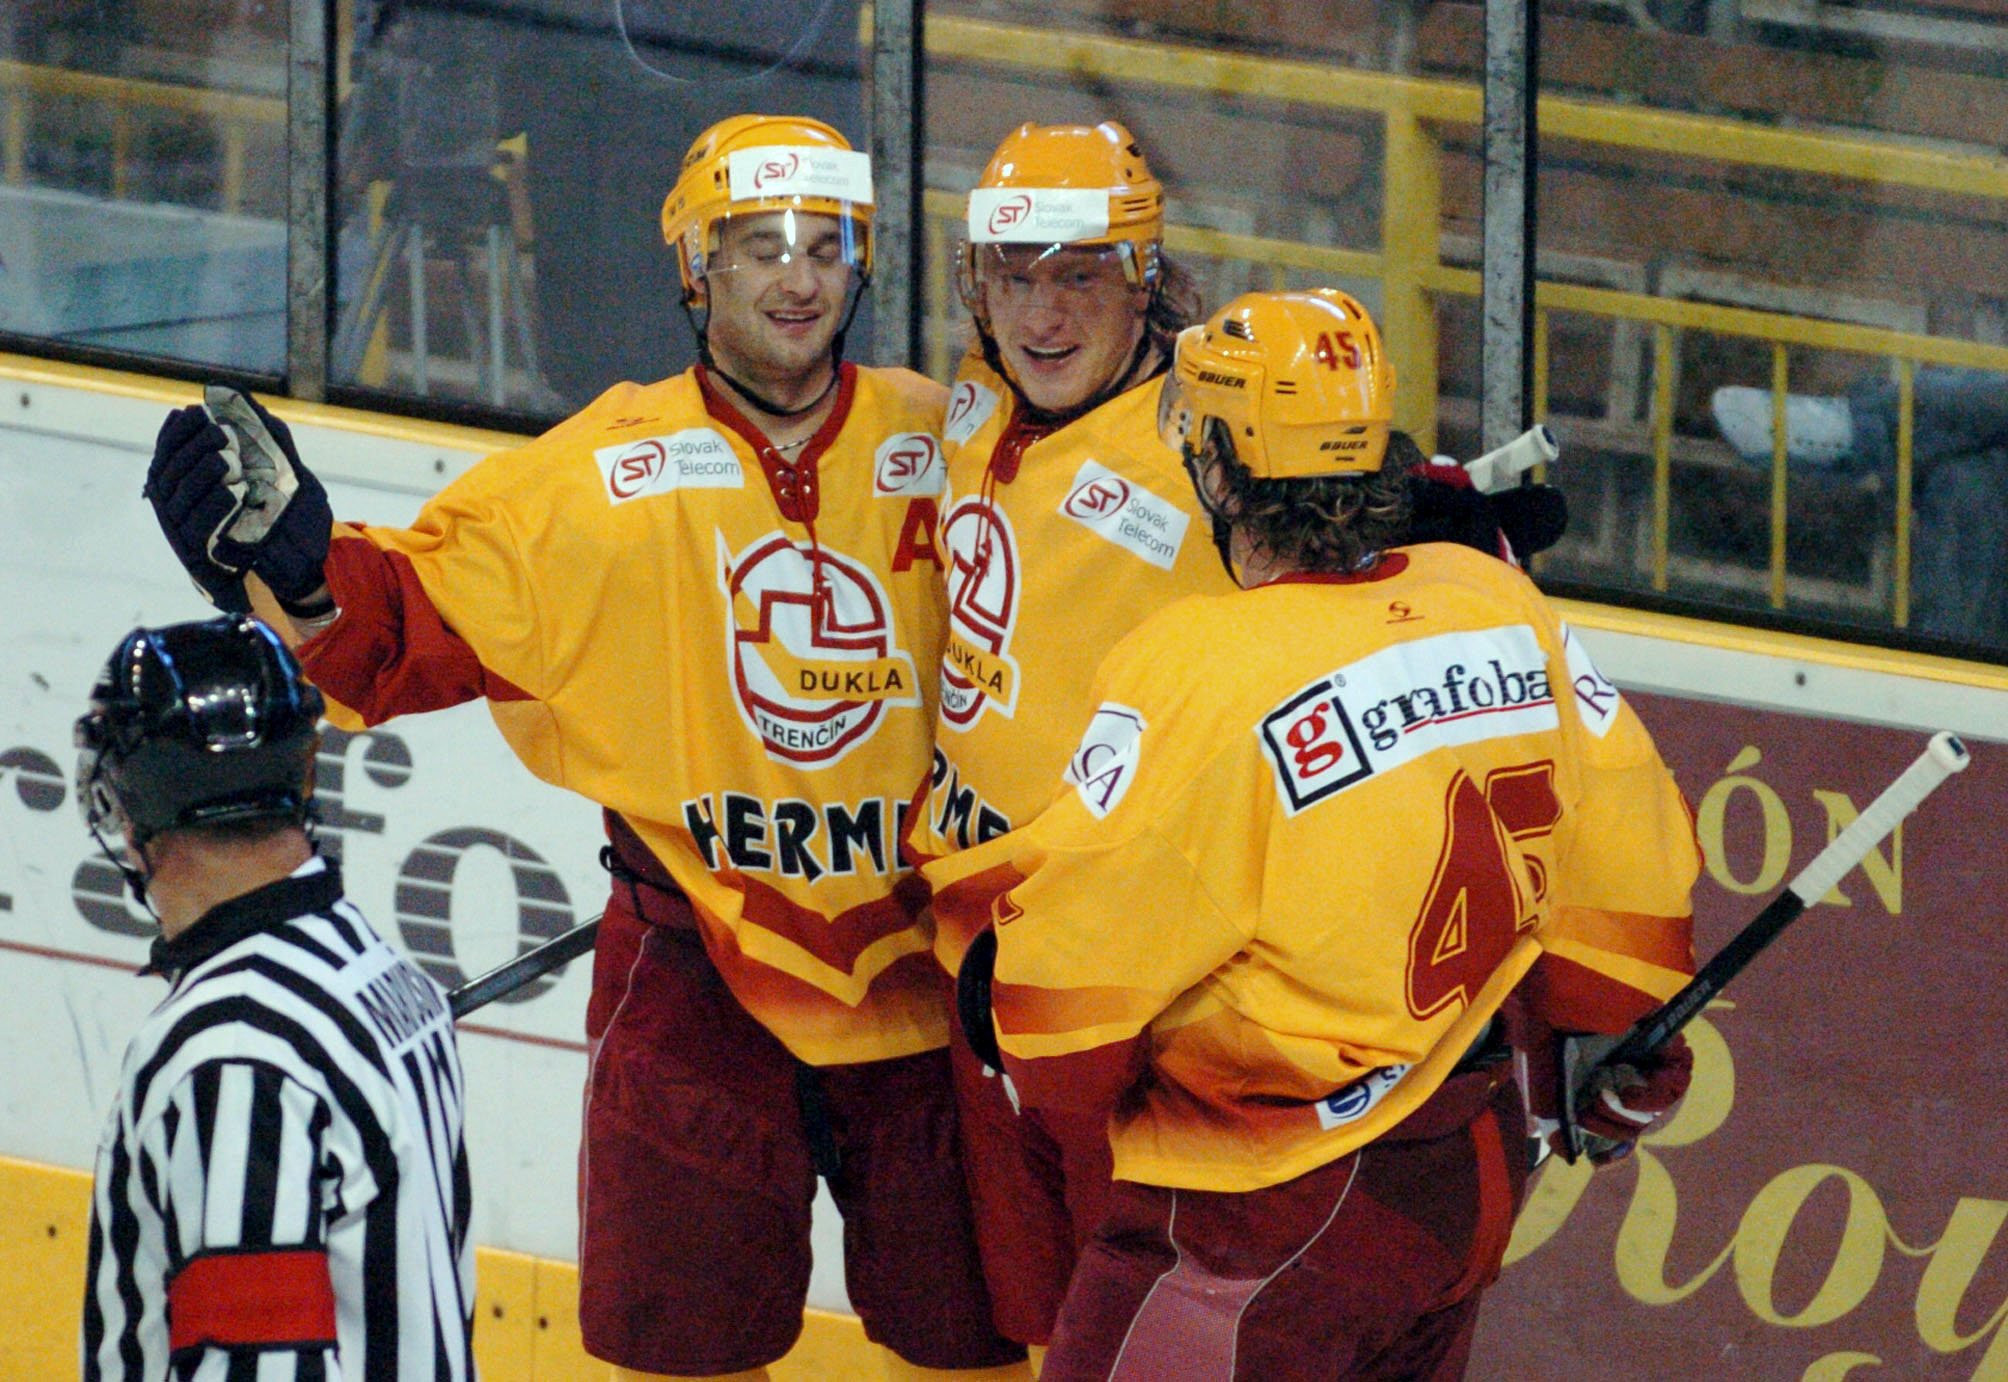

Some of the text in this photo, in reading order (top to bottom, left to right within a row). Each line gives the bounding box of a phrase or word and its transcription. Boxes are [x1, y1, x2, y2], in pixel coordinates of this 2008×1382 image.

[1314, 331, 1361, 371] 45
[1198, 370, 1247, 389] BAUER
[670, 440, 723, 456] Slovak
[673, 459, 740, 476] Telecom
[1126, 497, 1169, 532] Slovak
[891, 498, 945, 572] A
[1118, 517, 1175, 558] Telecom
[801, 668, 903, 693] DUKLA
[945, 642, 1003, 695] UKLA
[759, 715, 847, 748] TRENČÍN
